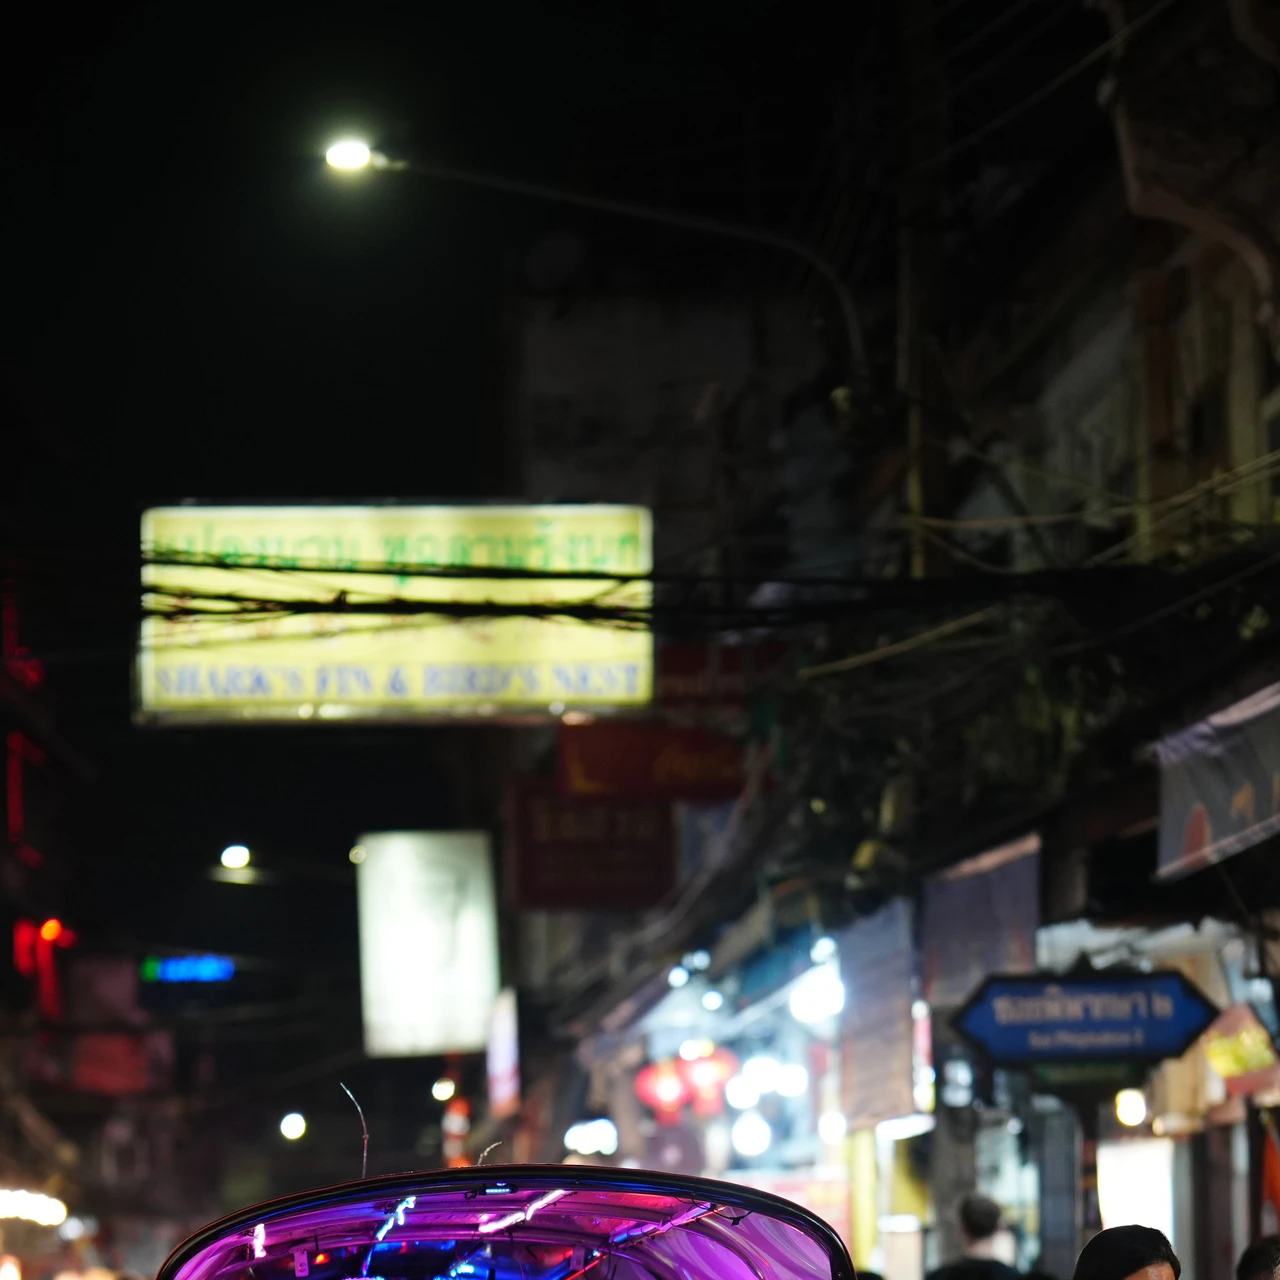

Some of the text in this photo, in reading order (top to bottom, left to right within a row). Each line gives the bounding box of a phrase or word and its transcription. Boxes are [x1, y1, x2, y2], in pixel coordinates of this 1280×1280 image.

[316, 664, 373, 696] FIN
[387, 665, 410, 695] &
[422, 663, 540, 696] BIRD'S
[552, 662, 640, 695] NEST
